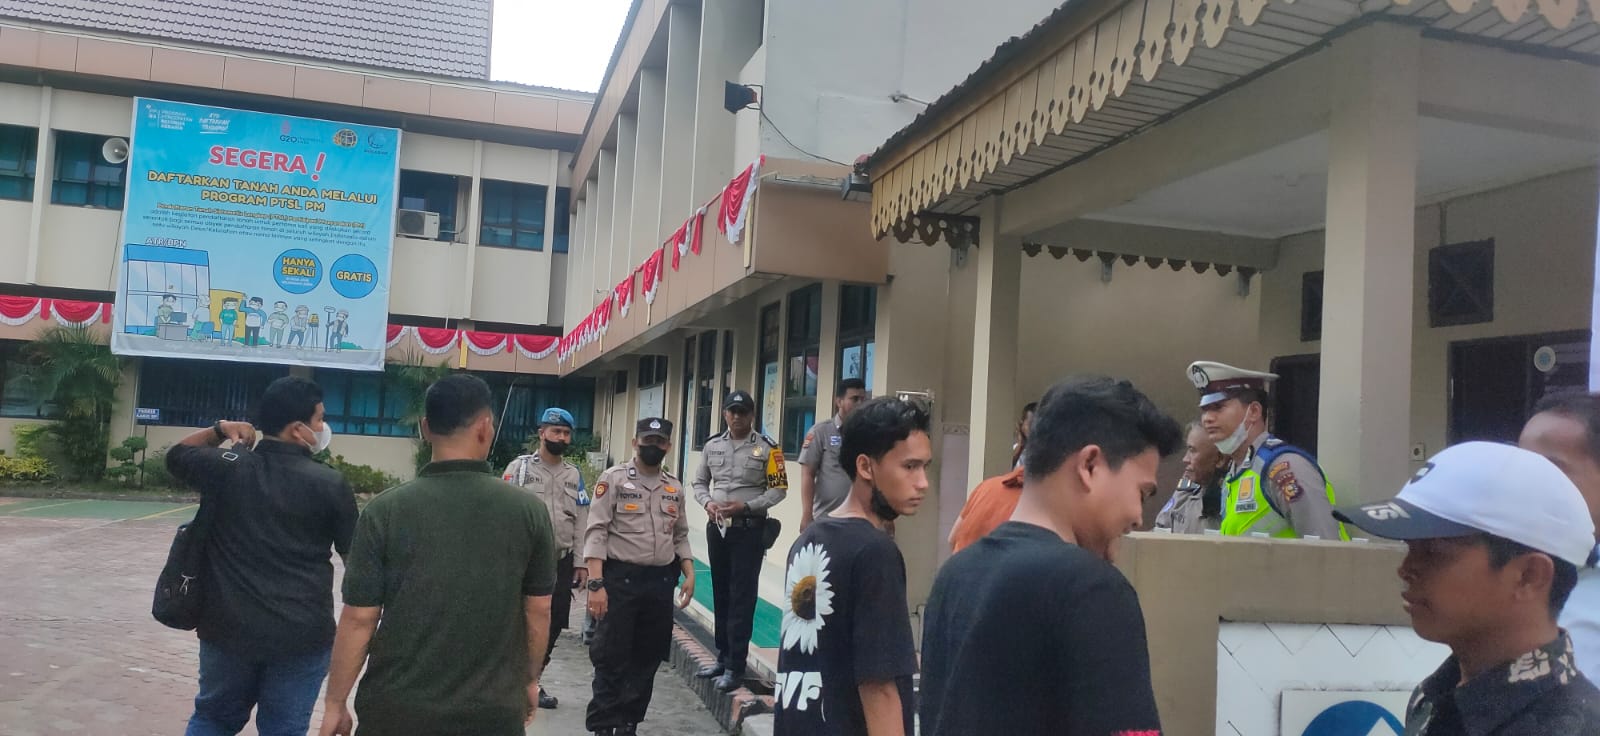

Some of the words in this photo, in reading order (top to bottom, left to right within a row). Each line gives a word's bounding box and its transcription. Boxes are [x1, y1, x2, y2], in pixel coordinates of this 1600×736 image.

[279, 134, 298, 143] G20
[147, 170, 230, 190] DAFTARKAN
[233, 179, 279, 194] TANAH
[281, 185, 318, 199] ANDA
[321, 189, 378, 205] MELALUI
[201, 190, 268, 207] PROGRAM
[269, 196, 303, 211] PTSL
[305, 201, 325, 212] PM
[145, 237, 188, 248] ATR/BPN
[282, 256, 316, 268] HANYA
[281, 266, 316, 278] SEKALI
[336, 270, 373, 284] GRATIS
